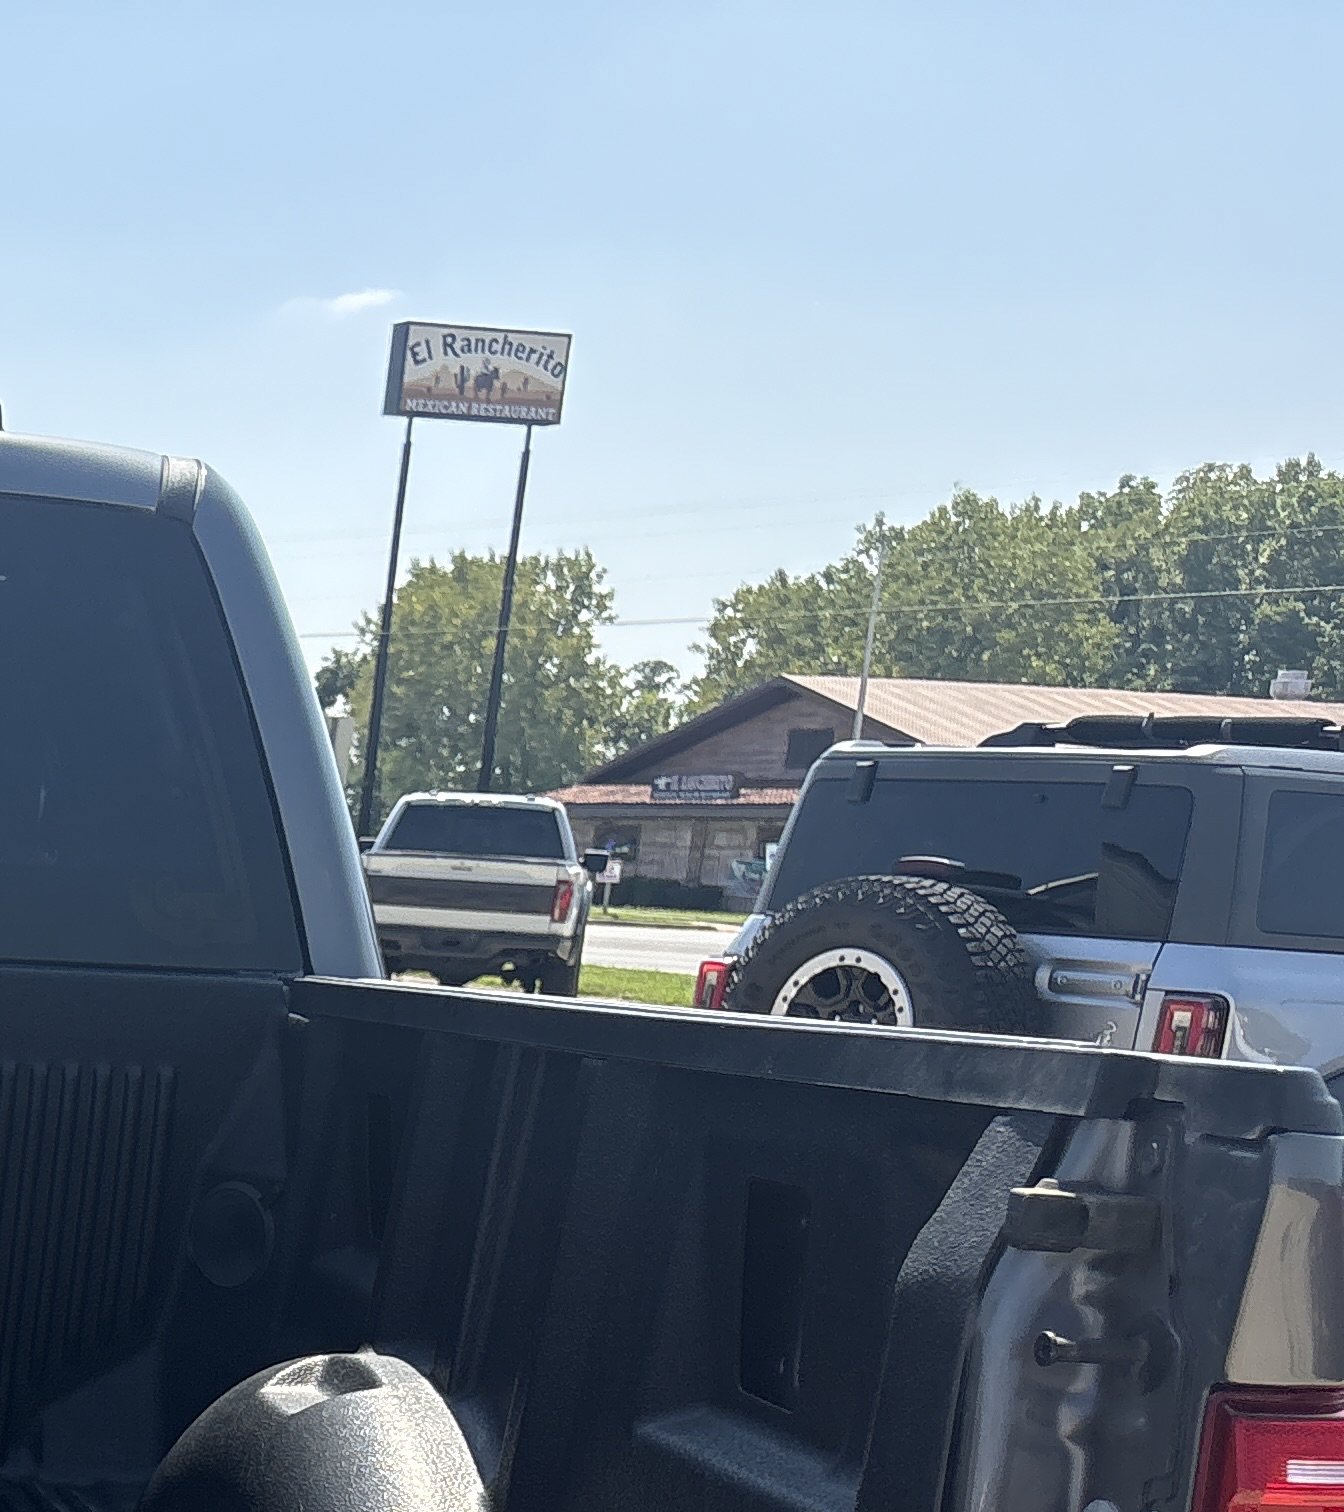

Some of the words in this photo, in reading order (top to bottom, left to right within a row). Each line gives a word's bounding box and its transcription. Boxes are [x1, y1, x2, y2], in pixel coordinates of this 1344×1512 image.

[408, 338, 434, 367] El
[441, 333, 567, 379] Rancherito
[405, 398, 468, 415] MEXICAN
[471, 403, 556, 421] RESTAURANT
